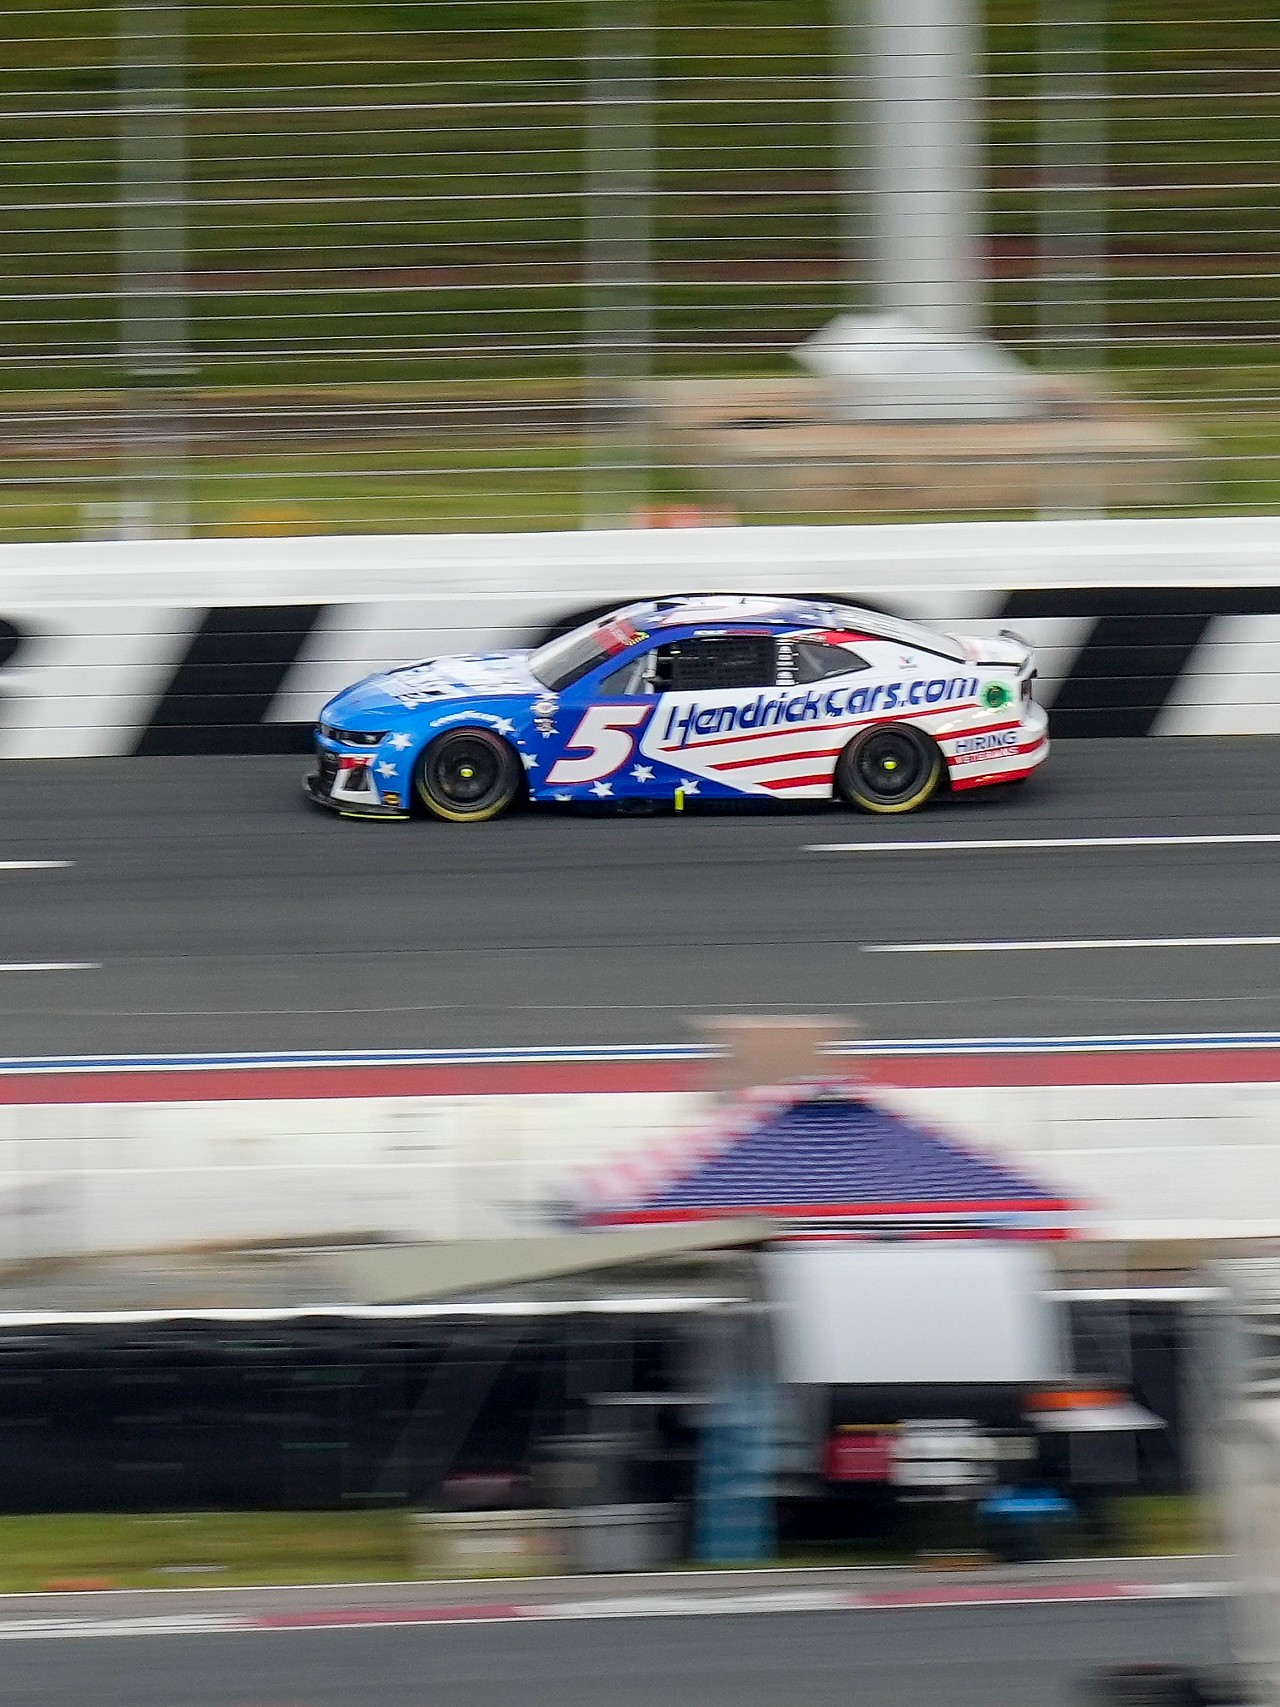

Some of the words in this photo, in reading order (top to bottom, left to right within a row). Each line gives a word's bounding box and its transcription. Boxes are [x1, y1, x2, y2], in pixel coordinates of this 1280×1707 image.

[544, 704, 654, 785] 5
[662, 677, 980, 748] HendrickCars.com
[955, 731, 1018, 754] HIRING
